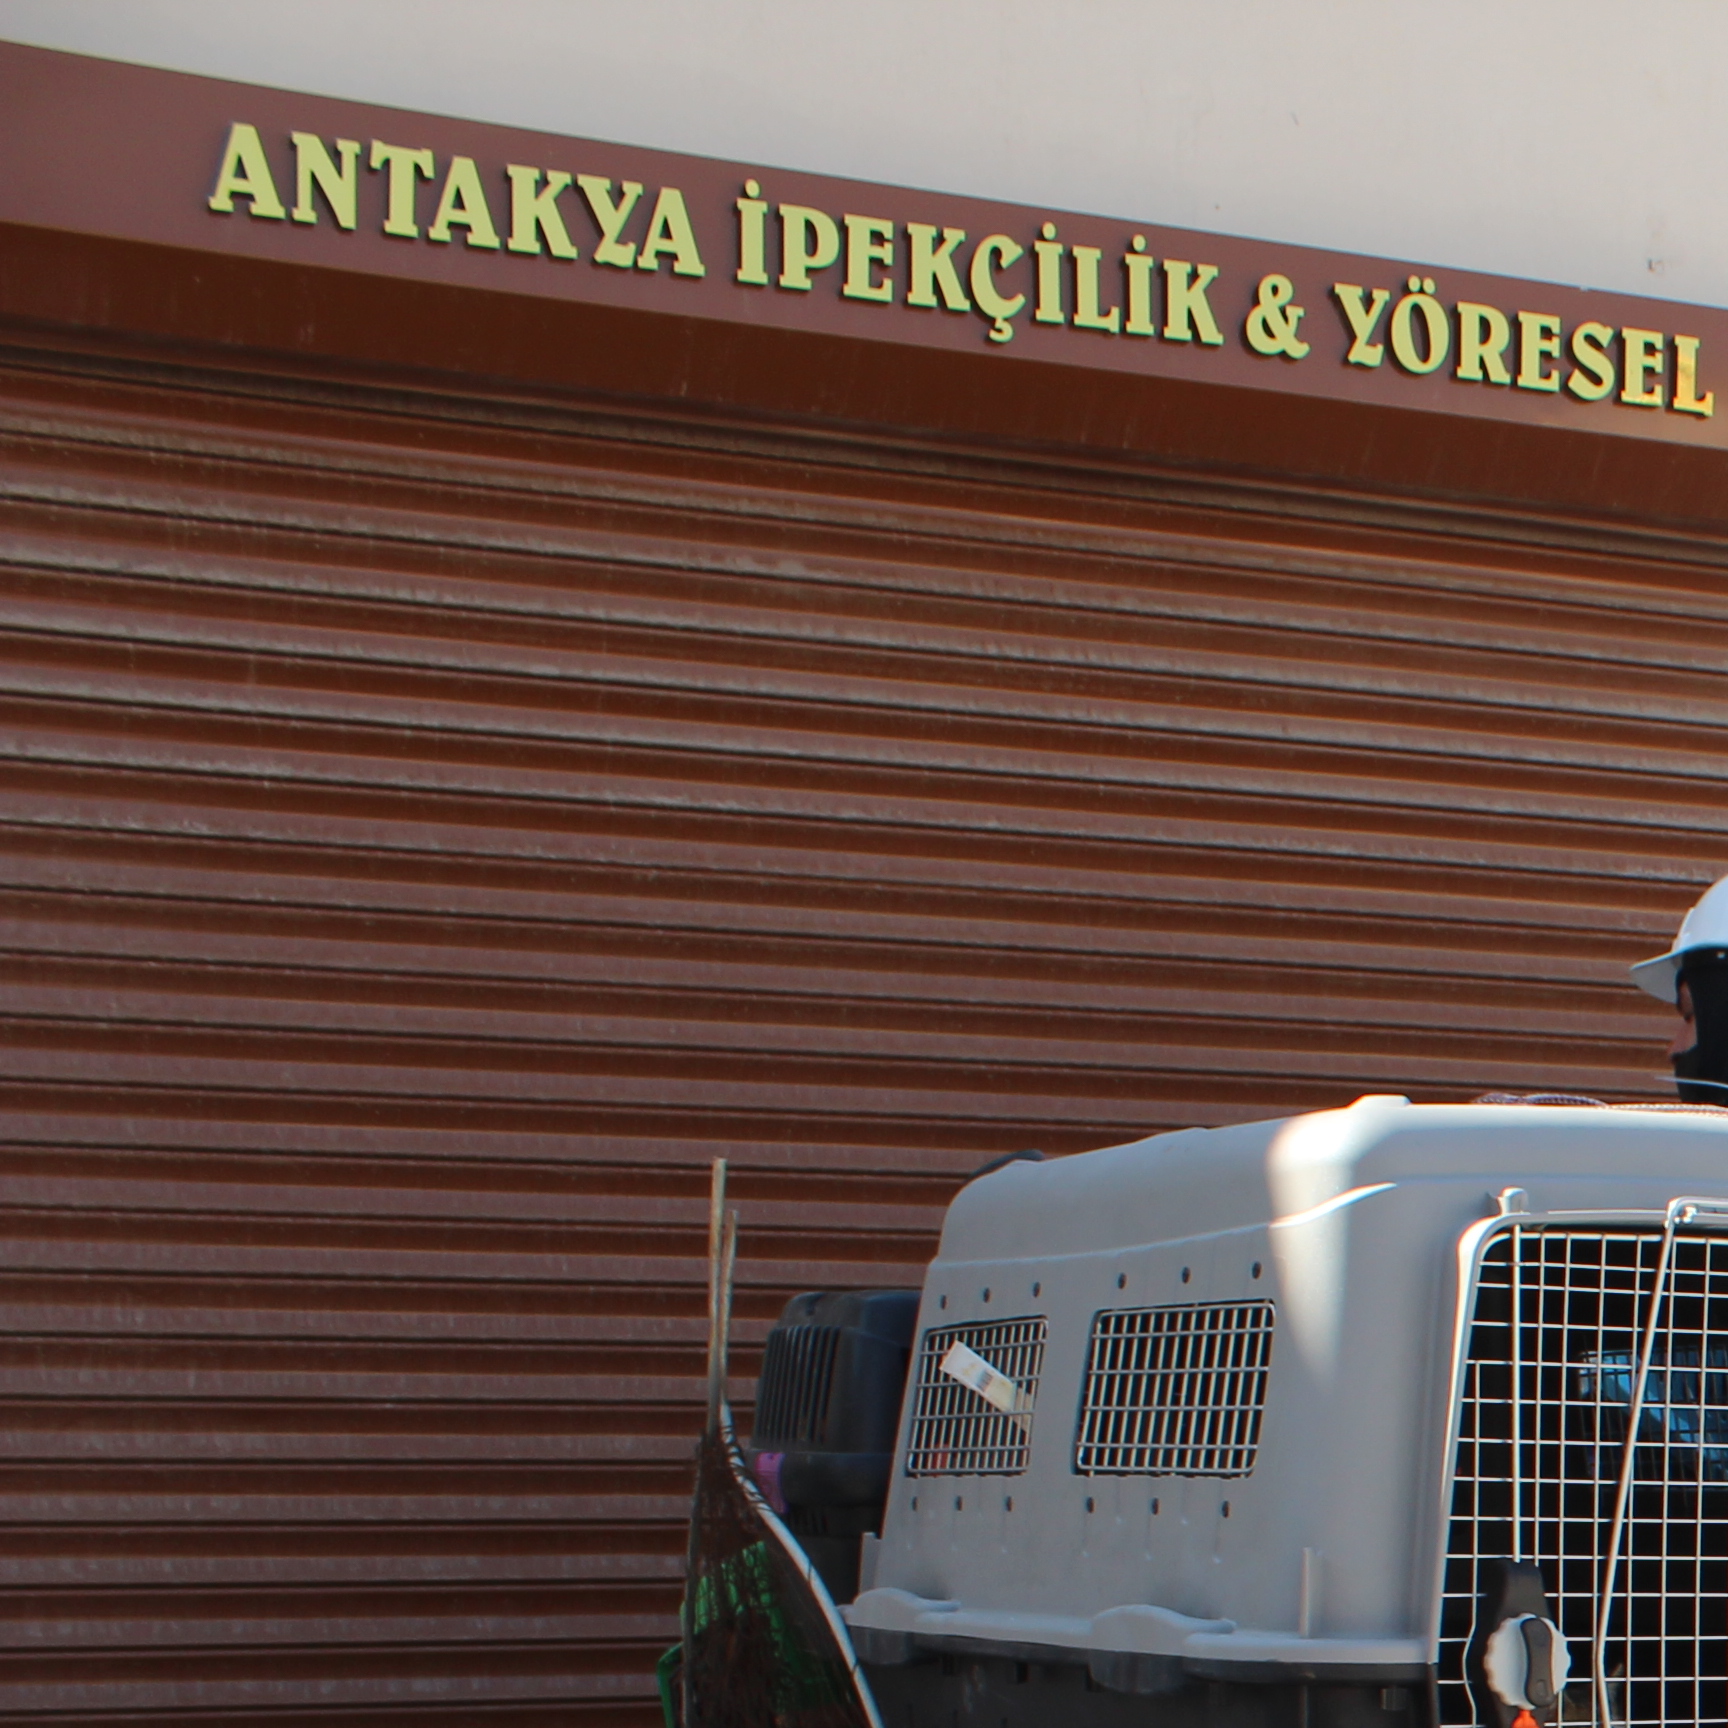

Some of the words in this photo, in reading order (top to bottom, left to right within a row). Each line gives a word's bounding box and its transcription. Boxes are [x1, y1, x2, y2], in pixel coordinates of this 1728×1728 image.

[207, 123, 706, 277] ANTAKYA
[735, 179, 1224, 346] İPEKÇİLİK
[1245, 273, 1311, 360] &
[1333, 276, 1715, 418] YÖRESEL
